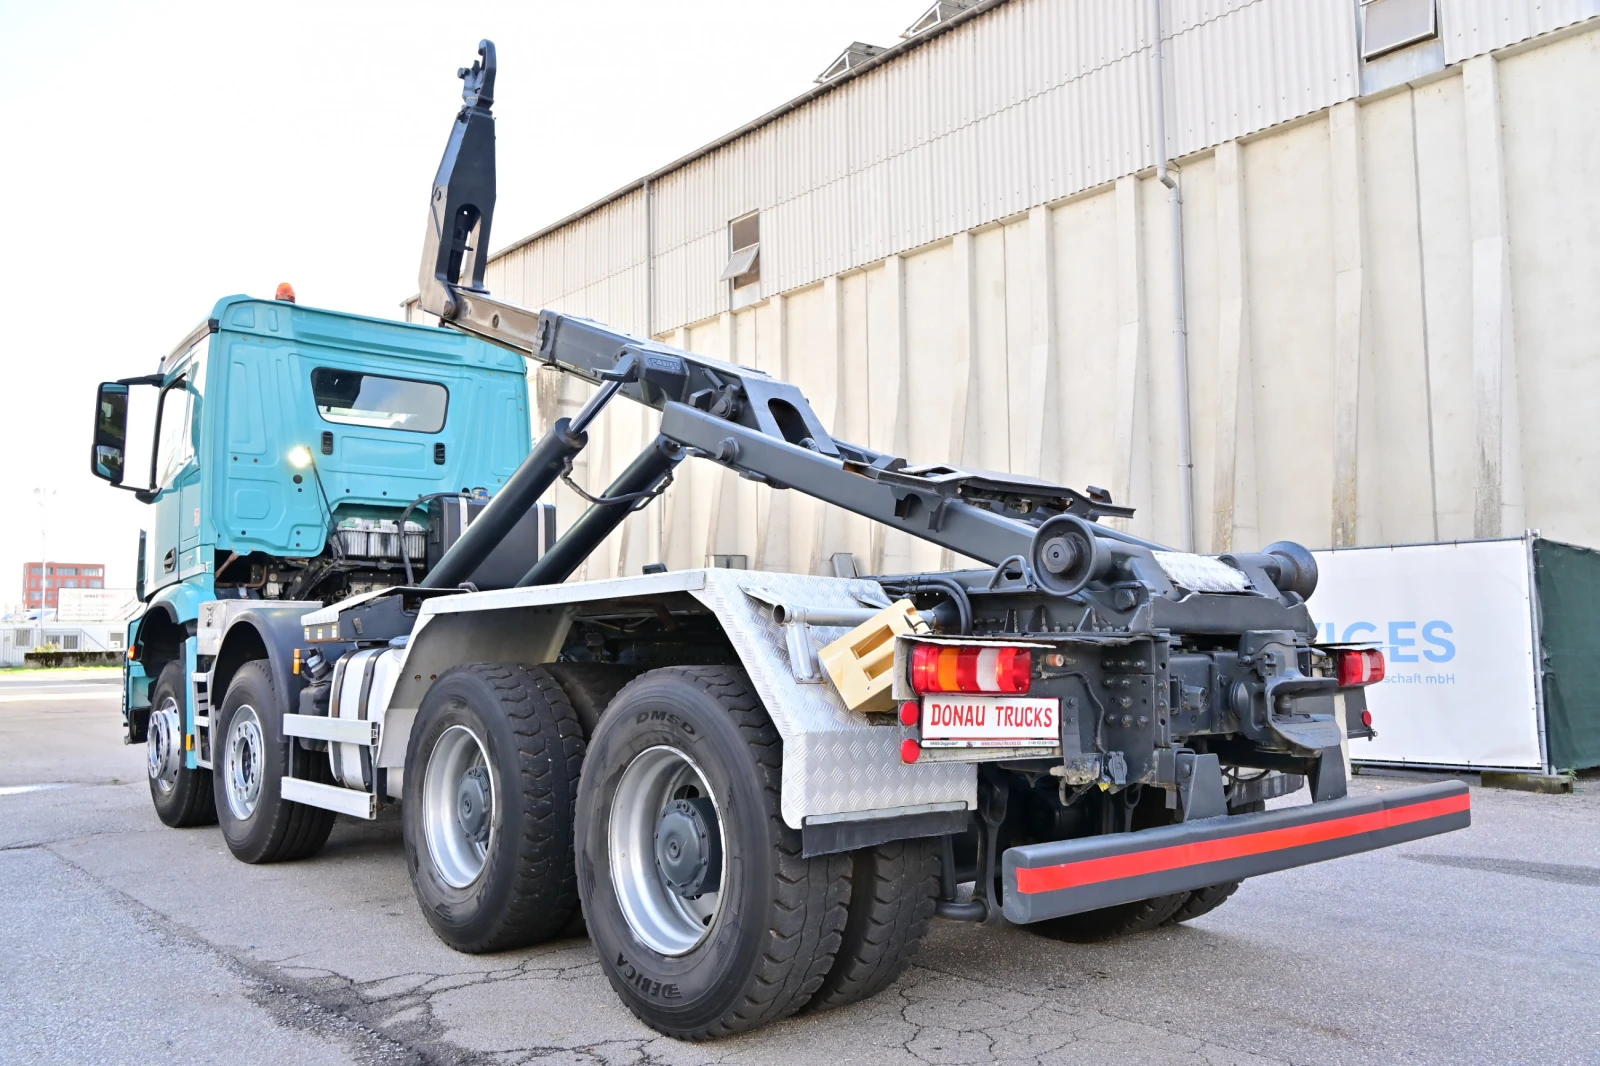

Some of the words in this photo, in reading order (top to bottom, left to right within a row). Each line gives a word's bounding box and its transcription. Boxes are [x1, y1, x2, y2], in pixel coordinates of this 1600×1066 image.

[1425, 673, 1455, 684] mbH
[636, 710, 696, 735] DMSD
[931, 704, 985, 726] DONAU
[995, 706, 1052, 727] TRUCKS
